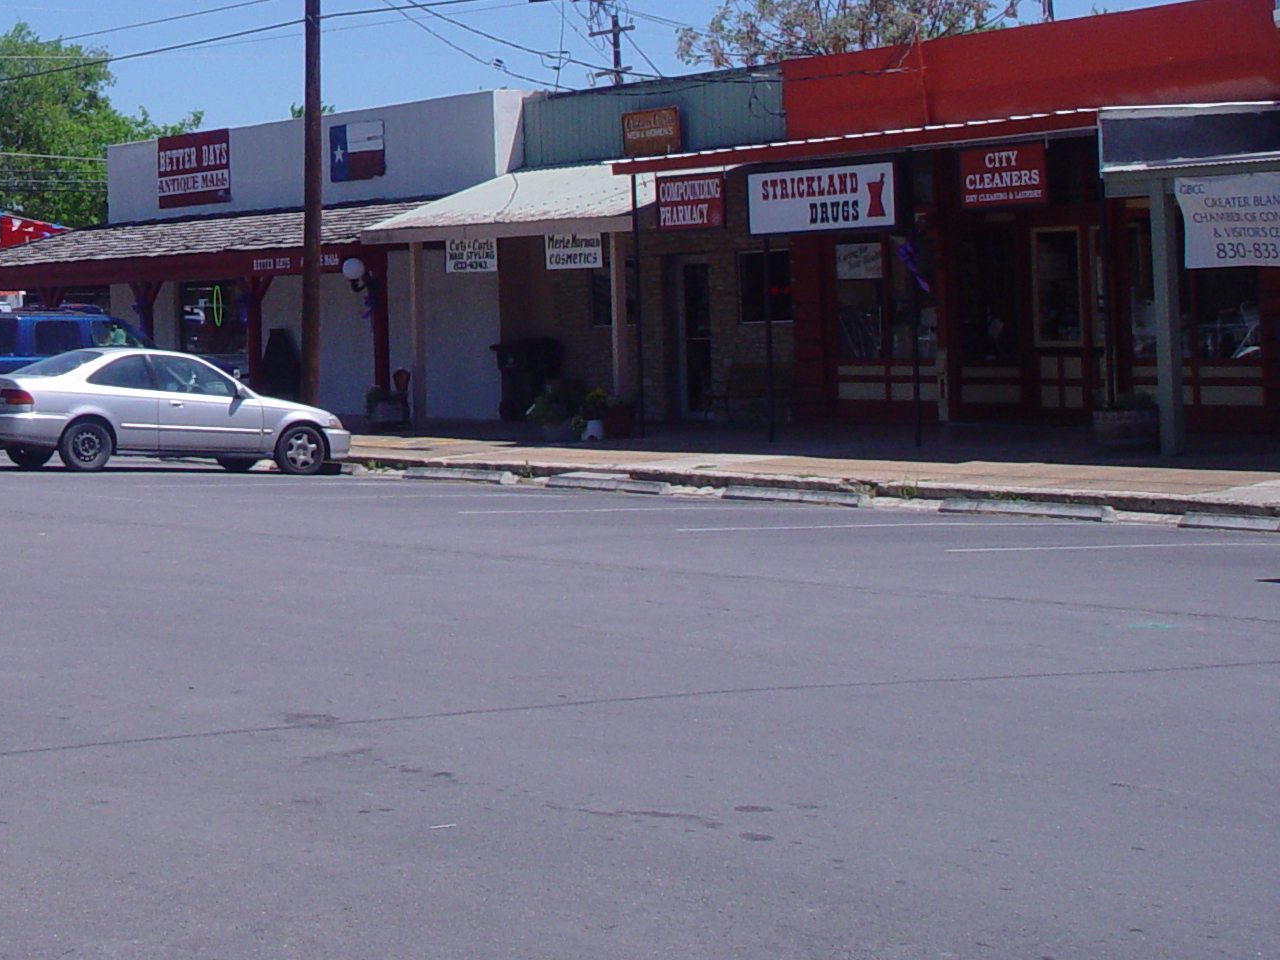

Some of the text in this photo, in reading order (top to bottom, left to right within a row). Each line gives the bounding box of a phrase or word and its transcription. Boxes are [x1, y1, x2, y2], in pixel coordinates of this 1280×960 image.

[159, 143, 227, 171] BETTER DAYS
[985, 150, 1018, 168] CITY
[158, 172, 228, 193] ANTIQUE MALL
[660, 178, 720, 202] COMPOUNDING
[761, 172, 859, 201] STRICKLAND
[966, 169, 1040, 190] CLEANERS
[660, 203, 709, 226] PHARMACY
[809, 200, 860, 224] DRUGS
[1224, 226, 1268, 238] VISITORS
